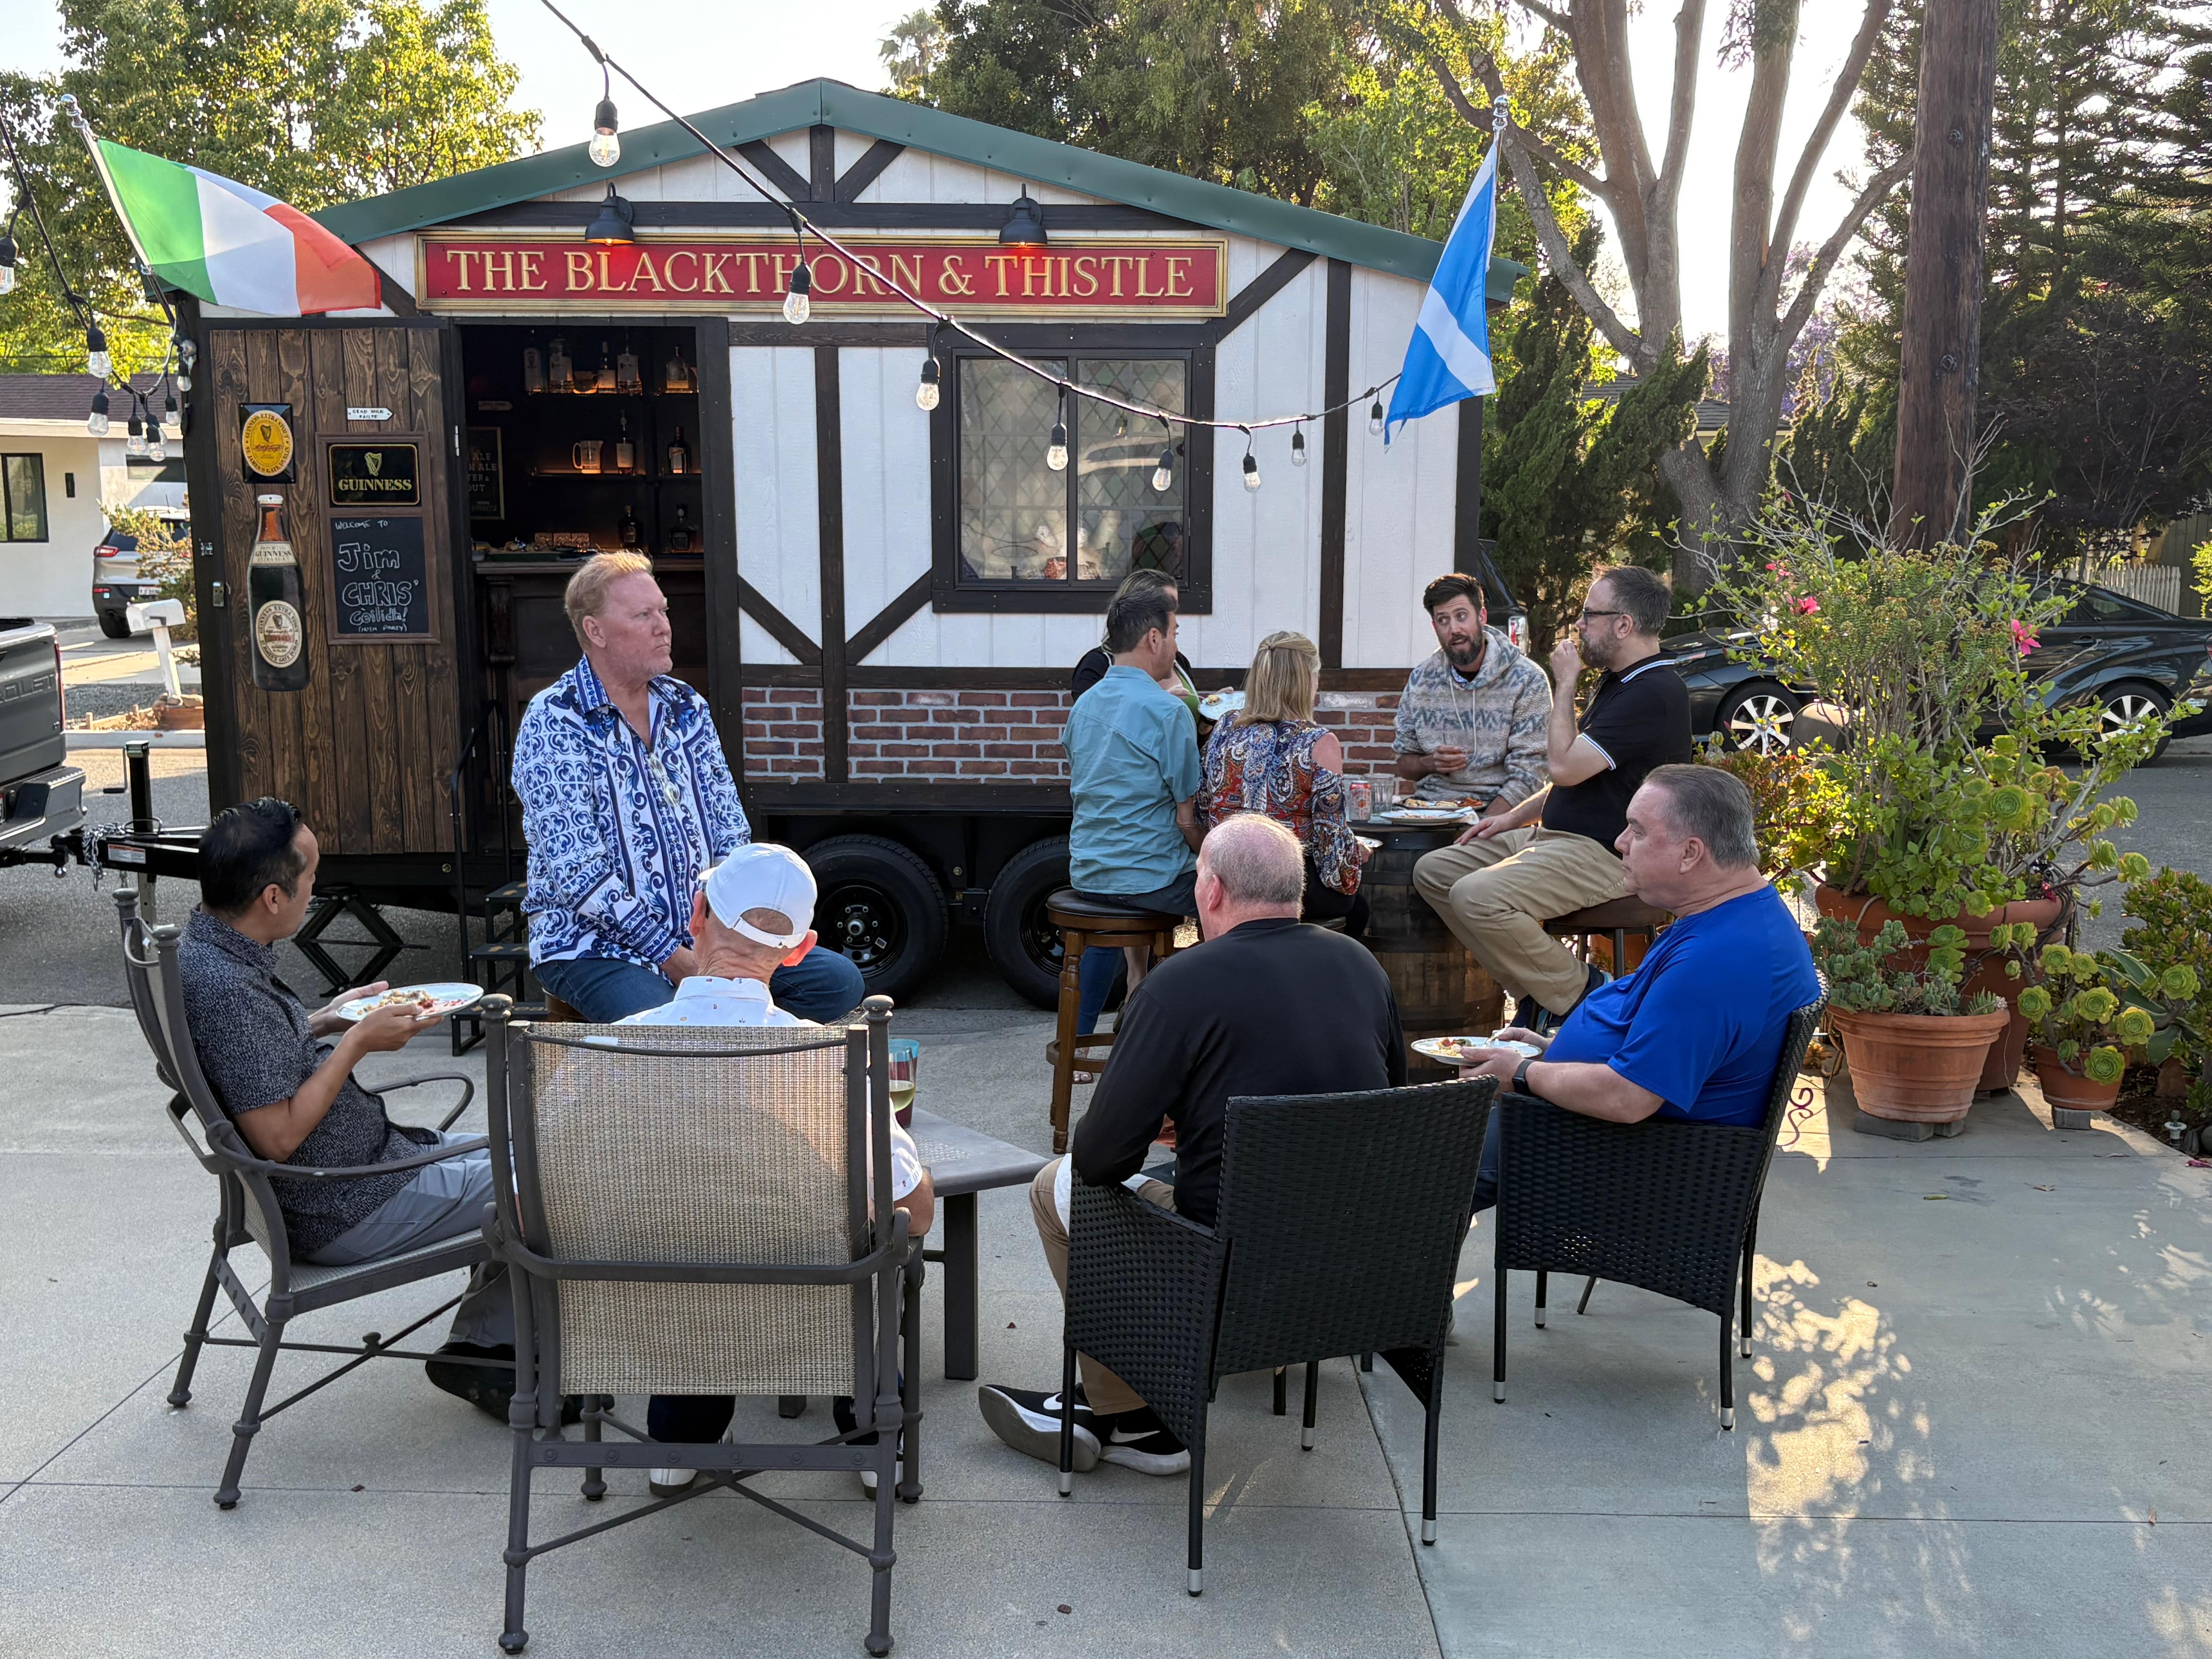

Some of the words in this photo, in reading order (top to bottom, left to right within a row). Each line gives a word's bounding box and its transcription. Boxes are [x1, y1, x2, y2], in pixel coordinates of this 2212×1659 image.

[447, 250, 548, 291] THE
[564, 251, 924, 295] BLACKTHORN
[938, 254, 975, 297] &
[984, 255, 1194, 297] THISTLE
[246, 416, 259, 438] GUINNESS
[260, 413, 278, 422] EXTRA
[278, 421, 290, 440] STOUT
[280, 447, 290, 467] DUBLIN
[338, 479, 412, 491] GUINNESS
[335, 520, 371, 530] WELCOME
[338, 542, 400, 572] Jim
[372, 569, 381, 580] &
[274, 606, 291, 616] EXTRA
[0, 674, 55, 704] OLET
